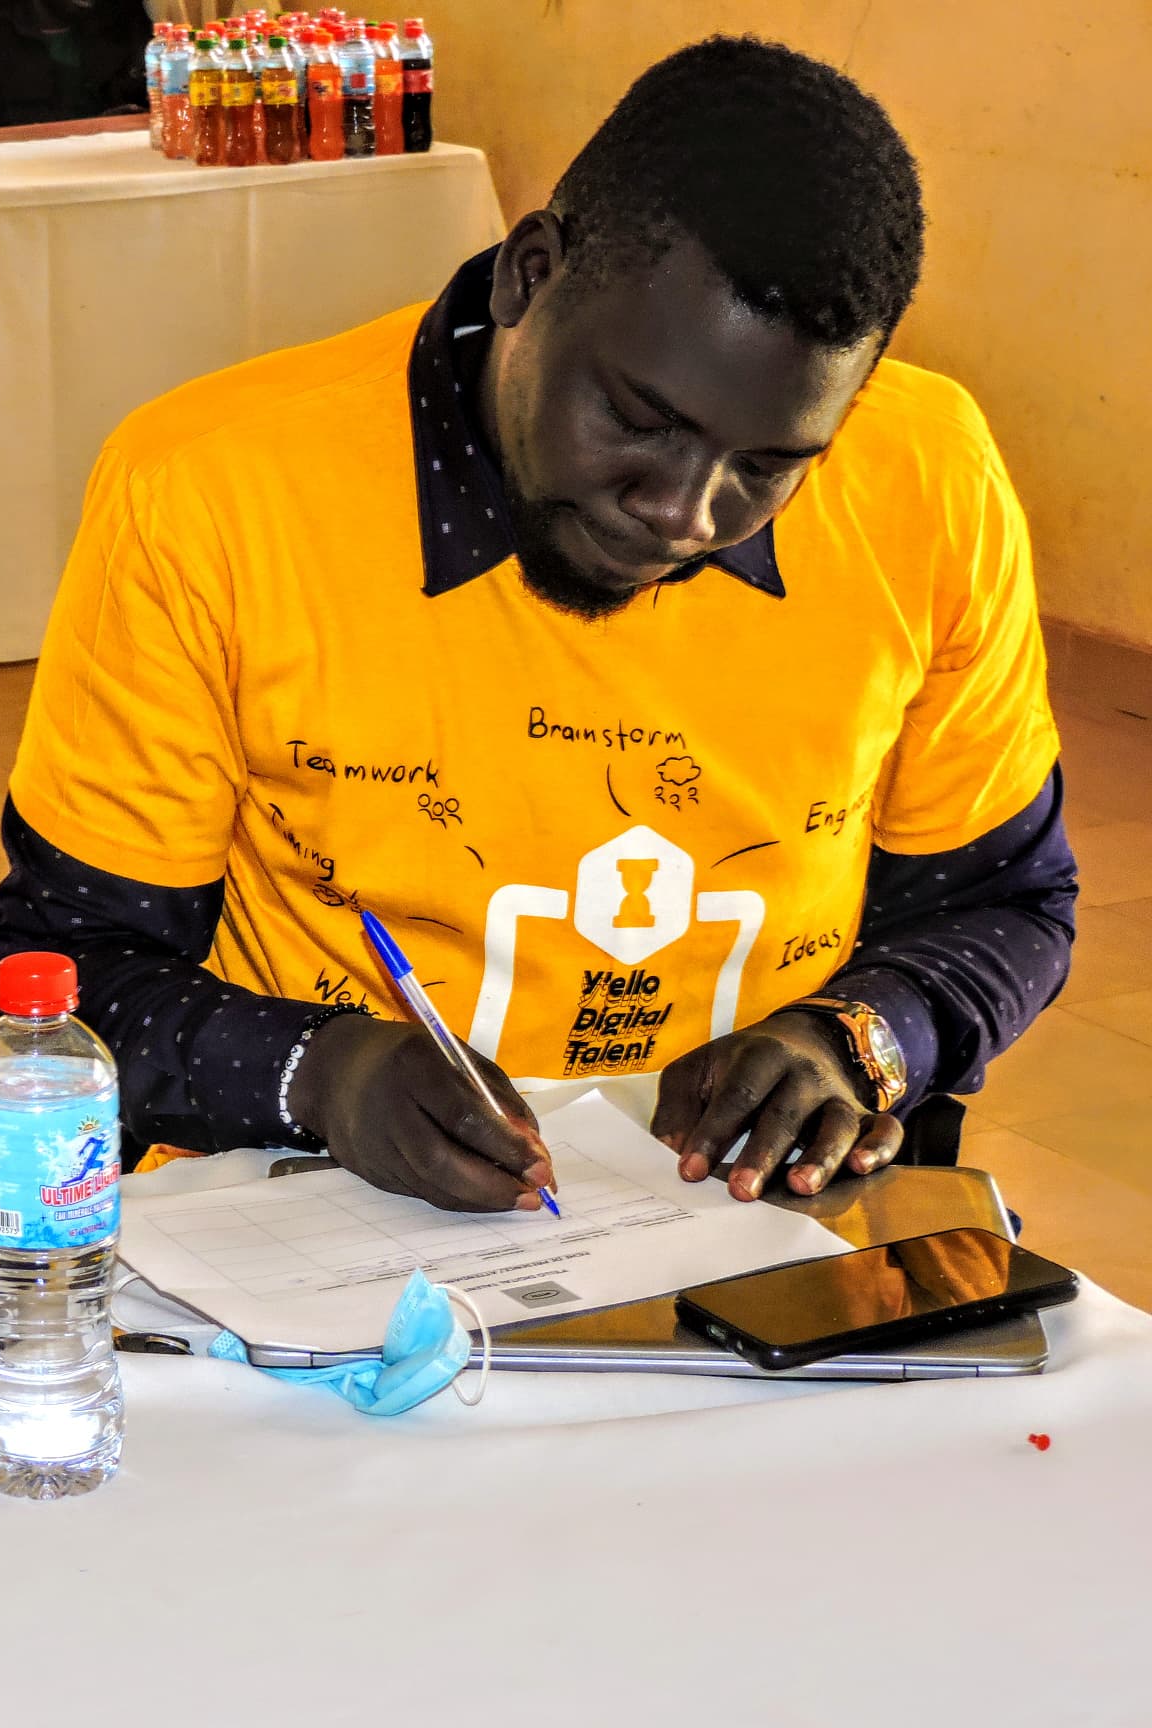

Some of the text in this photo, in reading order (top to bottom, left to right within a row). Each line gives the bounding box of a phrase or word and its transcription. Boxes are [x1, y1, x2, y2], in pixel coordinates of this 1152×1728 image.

[527, 706, 687, 752] Brainstorm
[285, 739, 439, 789] Teamwork
[268, 802, 335, 882] Timing
[776, 928, 841, 970] Ideas
[570, 1002, 673, 1036] Digital
[565, 1035, 656, 1067] Talent
[40, 1181, 92, 1206] ULTIME
